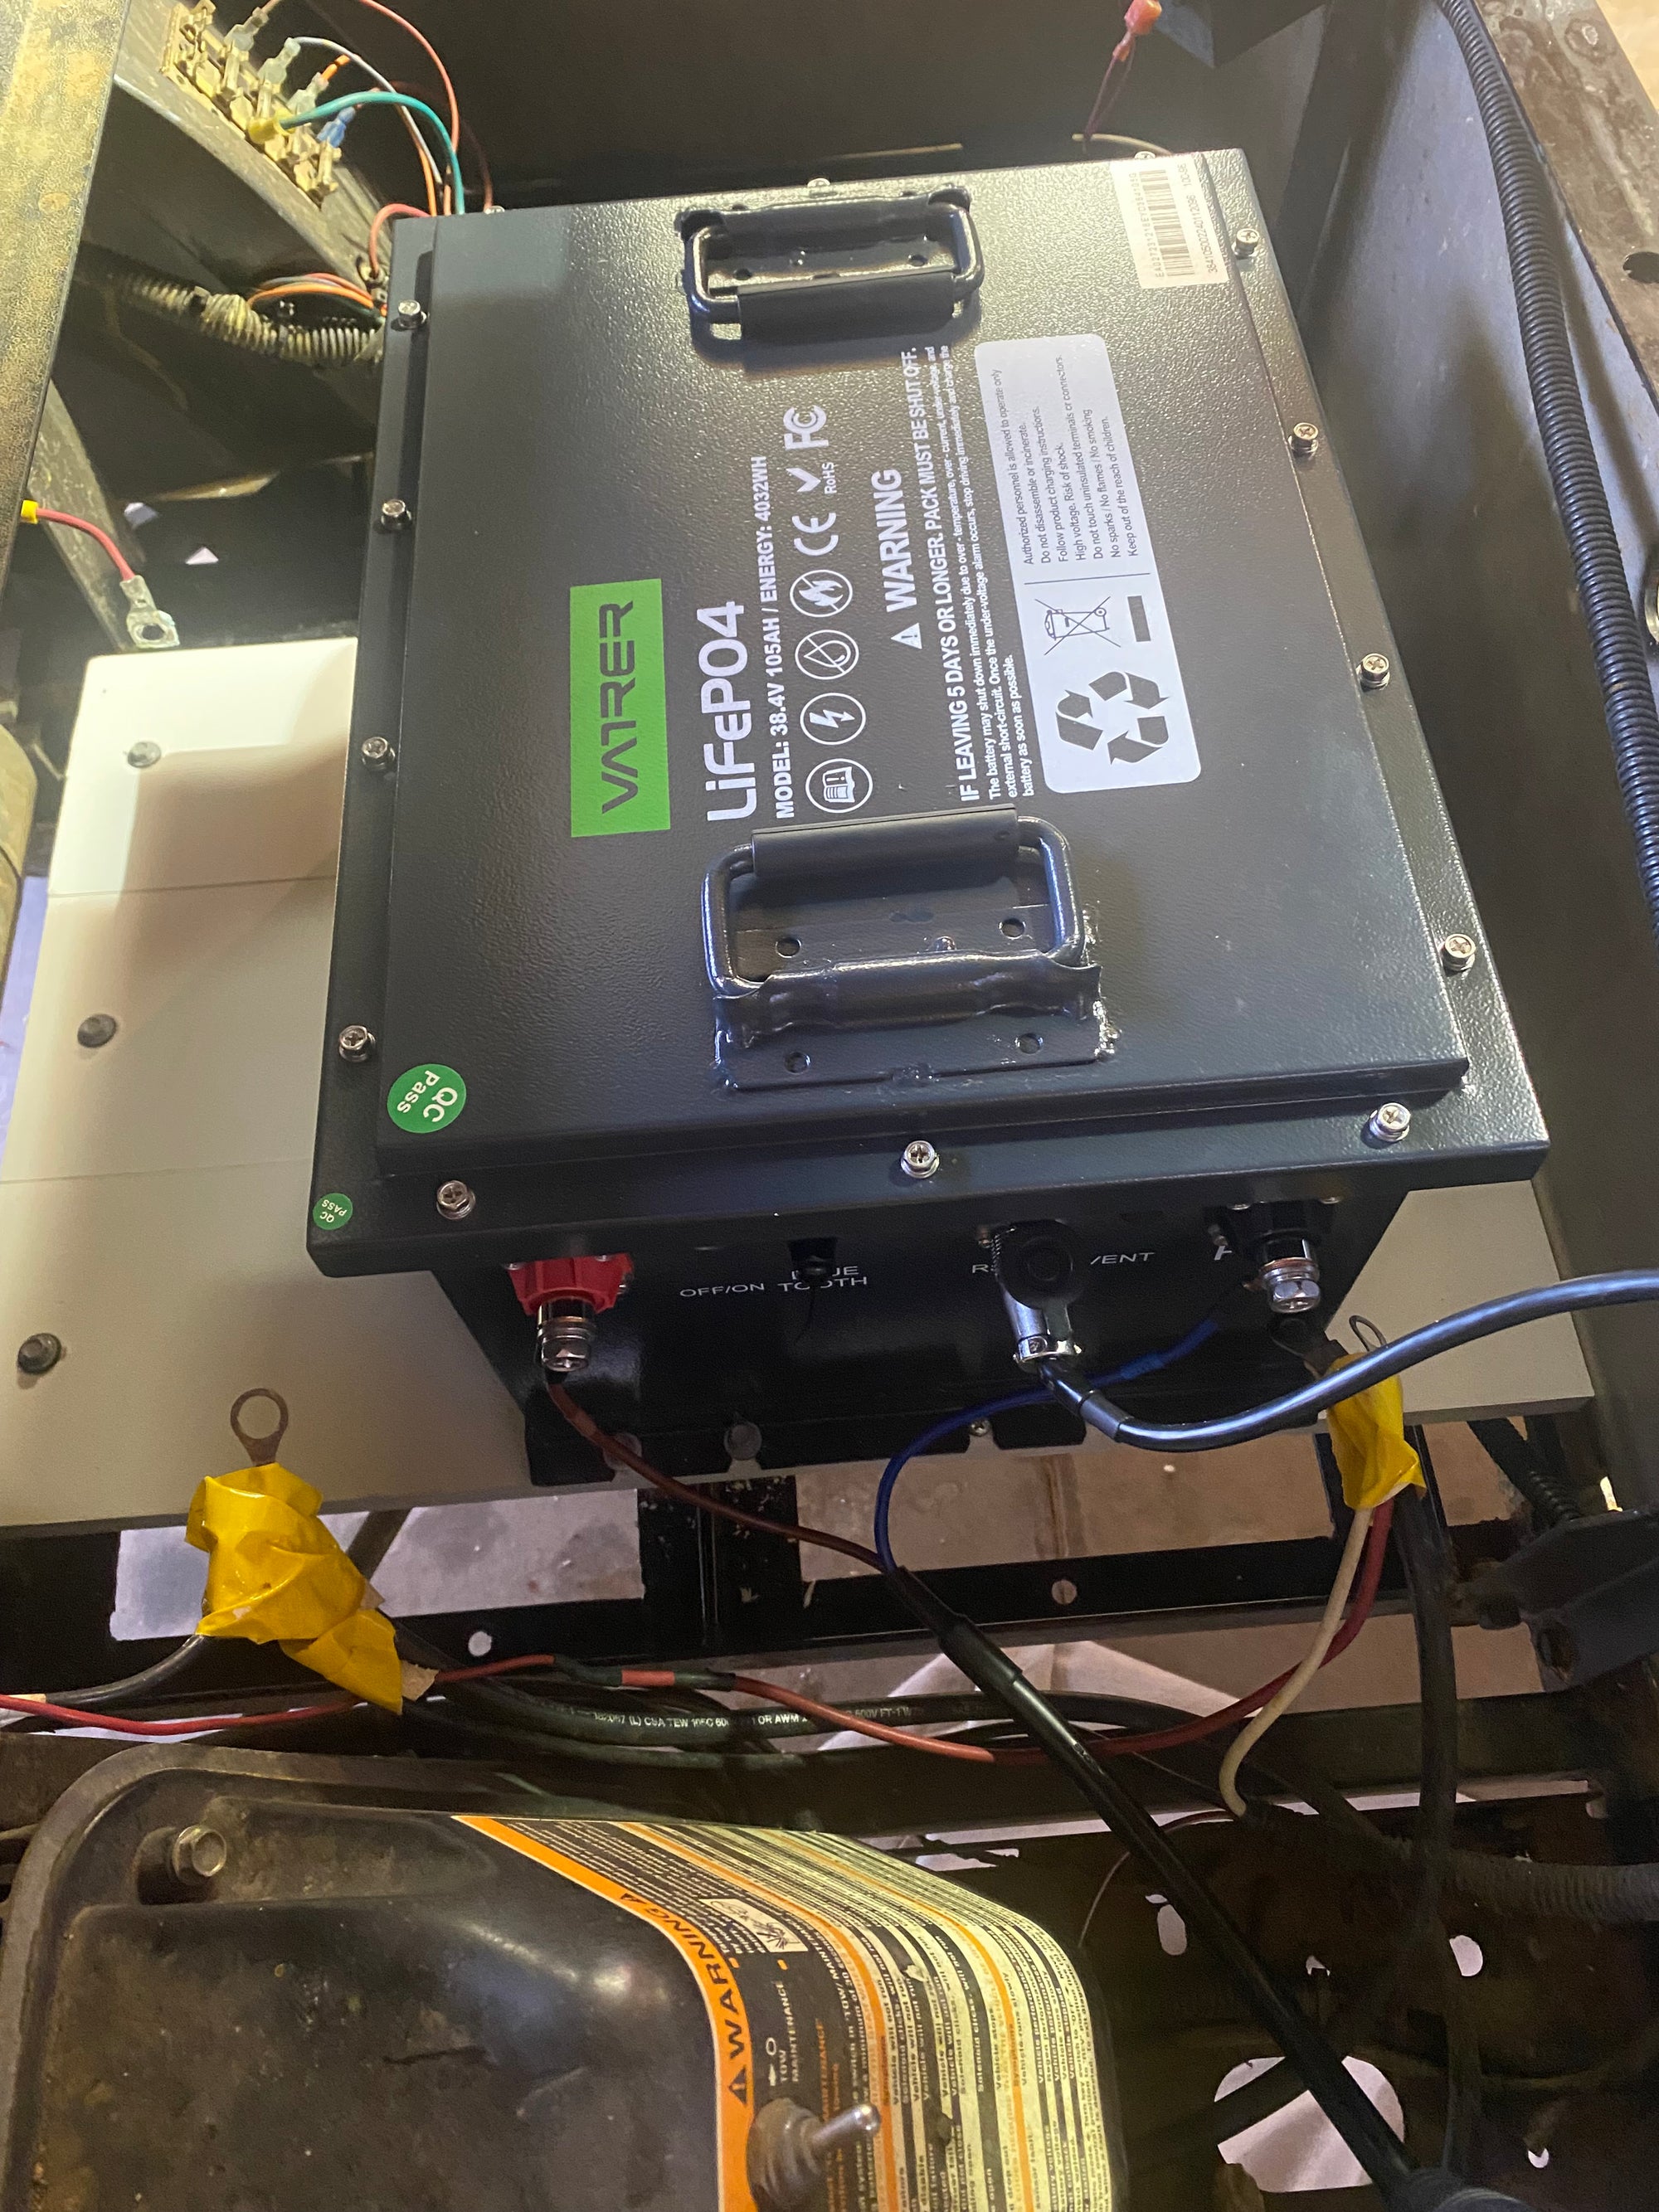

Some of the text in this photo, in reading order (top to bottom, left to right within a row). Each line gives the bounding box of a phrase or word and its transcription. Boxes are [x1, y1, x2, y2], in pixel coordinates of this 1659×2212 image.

[926, 347, 937, 362] and
[1065, 403, 1073, 411] or
[937, 420, 951, 453] current,
[1065, 413, 1082, 451] terminals
[1082, 410, 1097, 445] smoking
[945, 458, 955, 479] over
[991, 370, 1034, 566] Authorized personnel is allowed to operate only
[1089, 446, 1101, 458] No
[751, 456, 771, 522] 4032WH
[821, 461, 838, 495] RoHS
[1017, 423, 1052, 564] Do not disassemble or incinerate.
[1033, 406, 1069, 562] Follow product charging instructions.
[1073, 452, 1092, 501] uninsulated
[1095, 464, 1107, 493] flames
[1101, 416, 1139, 557] Keep out of the reach of children.
[947, 479, 963, 537] temperature,
[1055, 443, 1087, 561] High voltage. Risk of shock.
[1082, 503, 1097, 528] touch
[1099, 494, 1111, 508] No
[871, 469, 917, 613] WARNING
[1088, 529, 1101, 544] not
[1103, 513, 1119, 542] sparks
[756, 525, 778, 603] ENERGY:
[957, 542, 967, 564] over
[1092, 547, 1104, 559] Do
[1110, 545, 1121, 557] No
[902, 347, 980, 801] IF LEAVING 5 DAYS OR LONGER. PACK MUST BE SHUT OFF.
[941, 345, 1019, 798] external short-circuit. Once the under-voltage alarm occurs, stop driving immediately and charge the
[958, 566, 969, 576] to
[961, 577, 972, 596] due
[962, 597, 981, 657] immediately
[761, 618, 783, 678] 105AH
[973, 659, 985, 687] down
[599, 600, 639, 814] VATRER
[697, 601, 757, 821] LiFePO4
[766, 683, 788, 737] 38.4V
[975, 687, 990, 712] shut
[982, 713, 993, 737] may
[1003, 655, 1035, 797] battery as soon as possible.
[984, 738, 1000, 776] battery
[772, 741, 795, 819] MODEL:
[989, 778, 1003, 800] The
[397, 1070, 441, 1113] Pass
[422, 1087, 458, 1122] QC
[319, 1211, 334, 1223] QC
[321, 1199, 348, 1218] PASS
[679, 1282, 765, 1297] OFF/ON
[757, 1714, 773, 1725] OR
[774, 1713, 800, 1724] AWM
[645, 1908, 745, 2059] WARNING
[775, 1981, 799, 2082] MAINTENANCE
[778, 2049, 788, 2084] TOW
